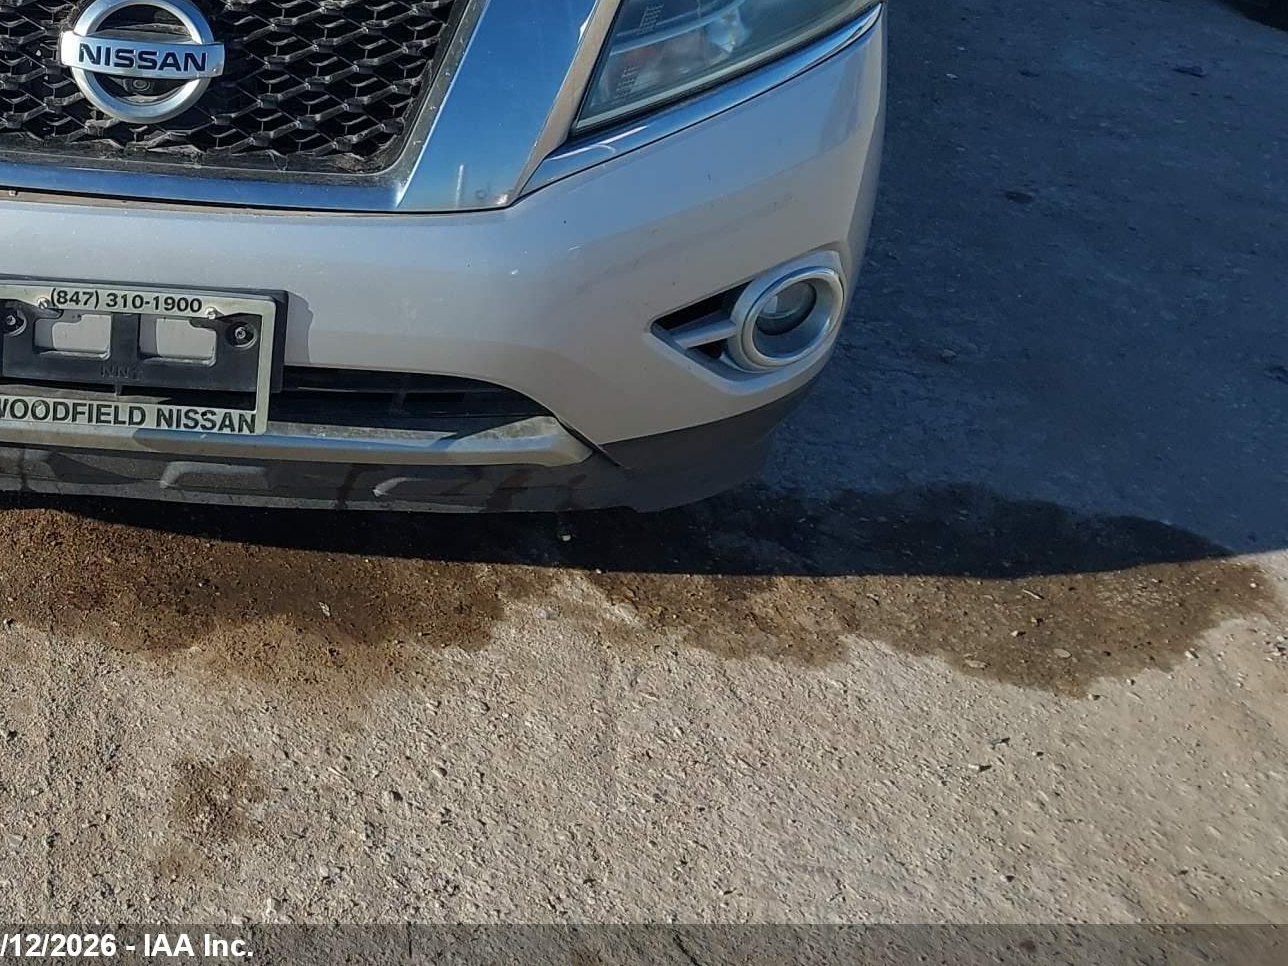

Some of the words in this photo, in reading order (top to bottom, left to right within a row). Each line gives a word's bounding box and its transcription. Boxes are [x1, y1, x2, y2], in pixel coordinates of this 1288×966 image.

[78, 42, 208, 73] NISSAN
[50, 287, 100, 310] (847)
[105, 291, 203, 314] 310-1900
[155, 406, 257, 434] NISSAN
